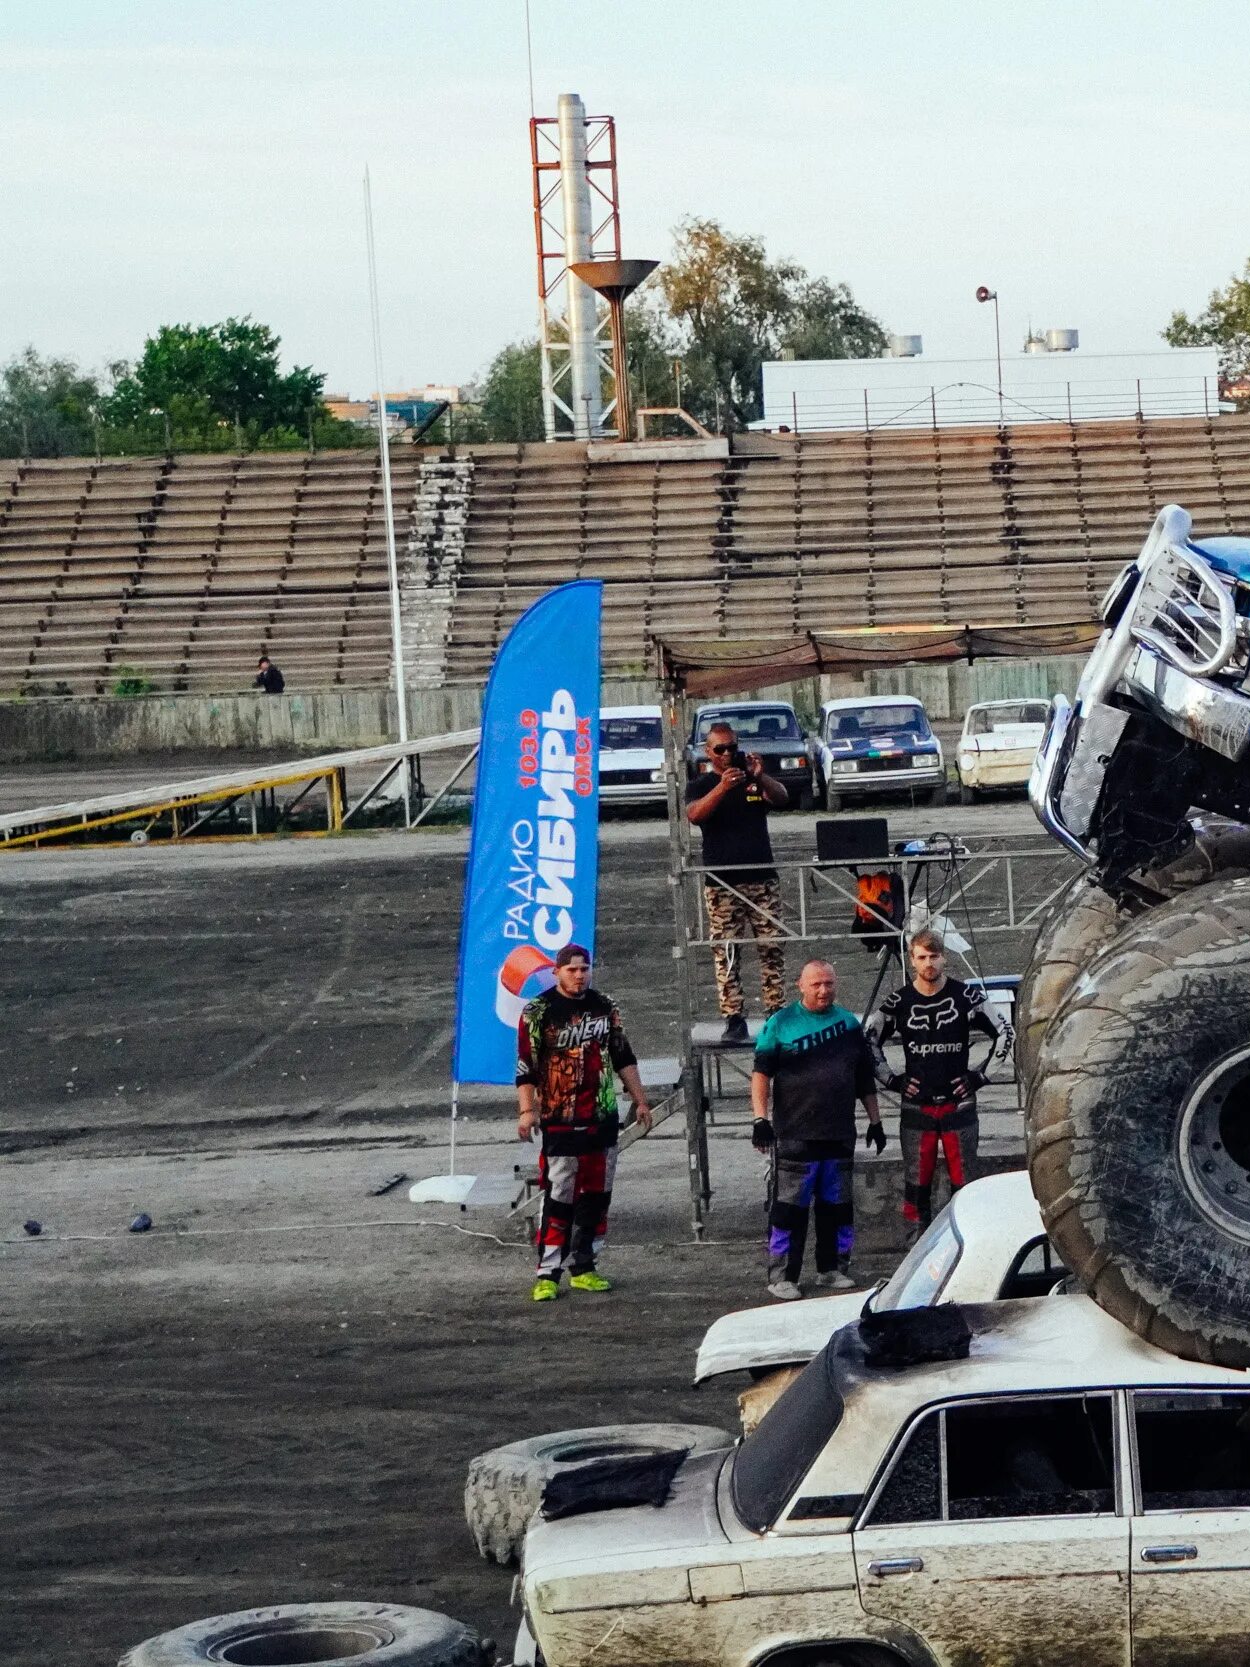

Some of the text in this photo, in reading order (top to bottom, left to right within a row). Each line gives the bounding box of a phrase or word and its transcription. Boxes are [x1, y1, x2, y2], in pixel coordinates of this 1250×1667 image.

[519, 709, 538, 788] 103.9
[573, 716, 592, 797] ОМСК
[533, 689, 577, 951] СИБИРЬ
[503, 819, 534, 939] РАДИО
[791, 1020, 849, 1054] THOR
[908, 1041, 963, 1058] Supreme
